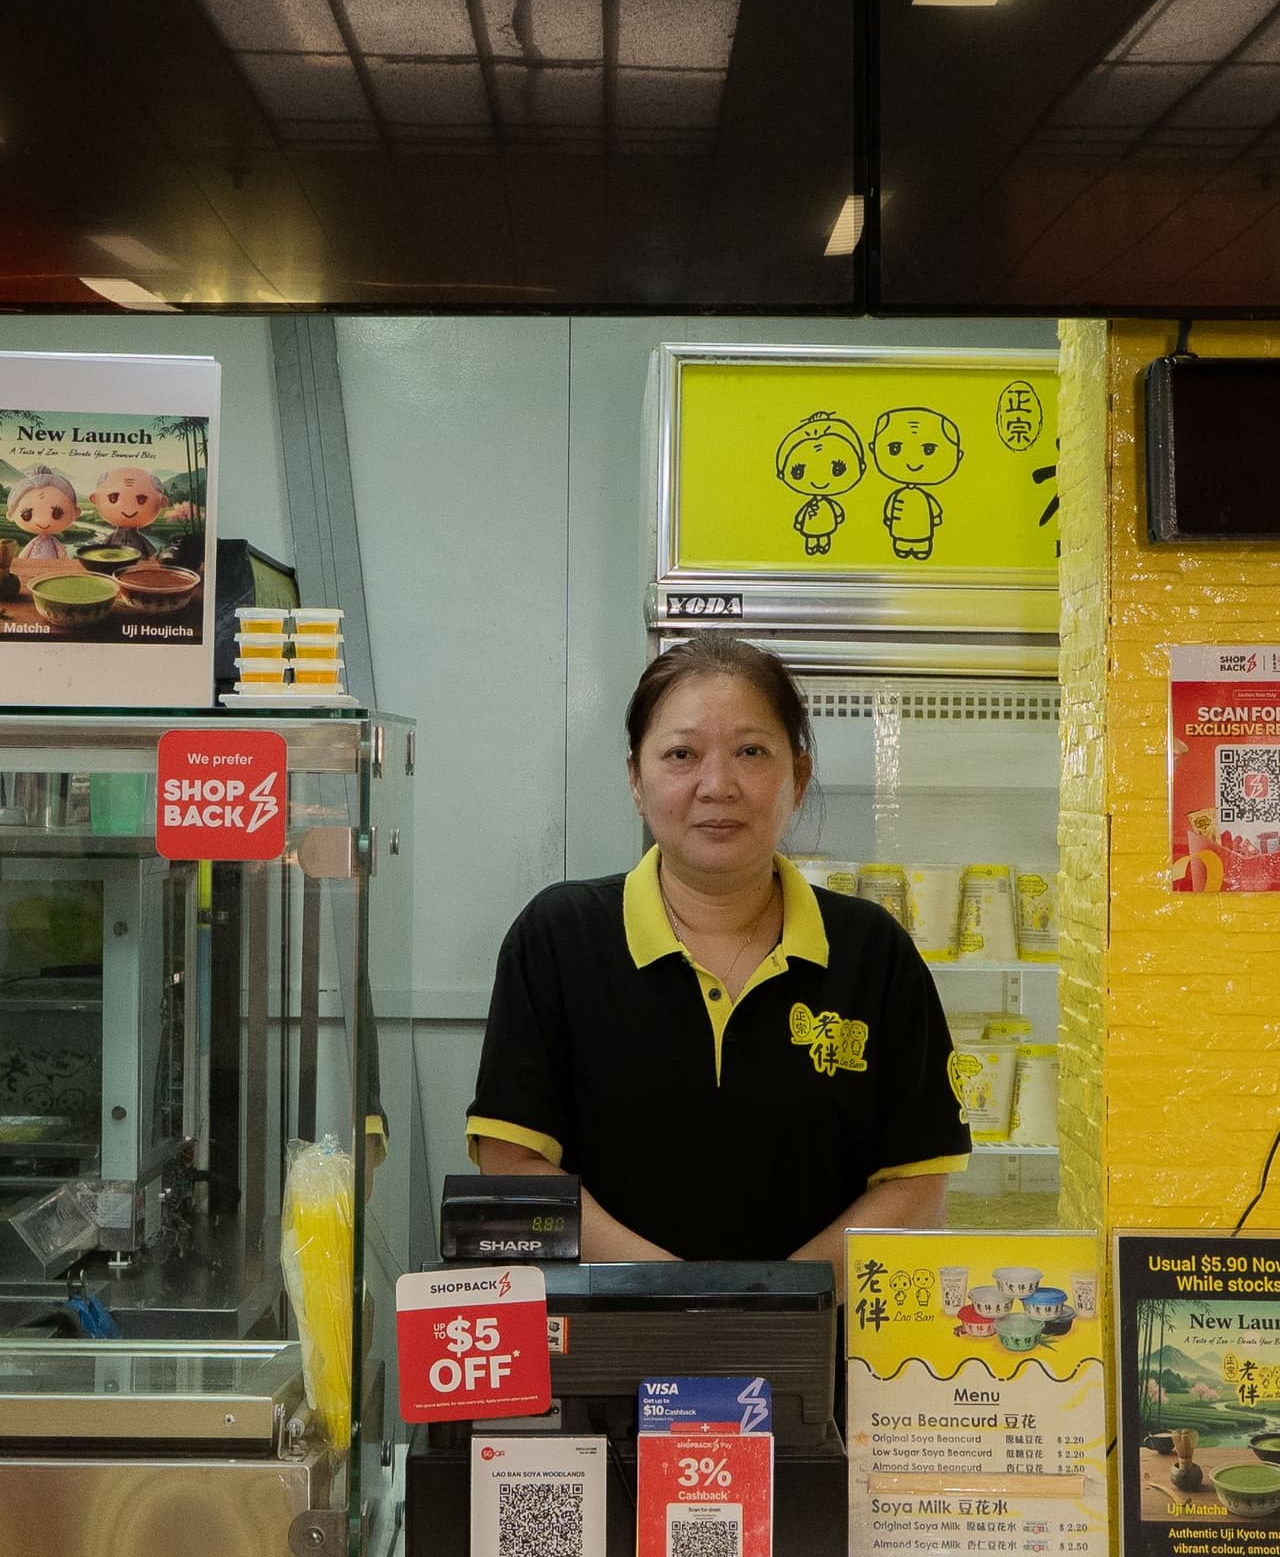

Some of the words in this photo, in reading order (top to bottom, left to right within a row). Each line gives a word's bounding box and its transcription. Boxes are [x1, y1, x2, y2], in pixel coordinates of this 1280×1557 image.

[1007, 389, 1032, 444] 正宗
[17, 425, 65, 442] New
[72, 427, 153, 445] Launch
[4, 621, 50, 635] Matcha
[121, 624, 138, 638] Uji
[141, 625, 194, 639] Houjicha
[1220, 655, 1246, 664] SHOP
[1220, 664, 1246, 672] BACK
[1198, 707, 1248, 721] SCAN
[1185, 724, 1263, 736] EXCLUSIVE
[187, 753, 209, 764] We
[213, 754, 253, 767] prefer
[163, 779, 245, 802] SHOP
[164, 805, 245, 827] BACK
[813, 1015, 840, 1073] 老伴
[479, 1241, 542, 1251] SHARP
[1149, 1256, 1195, 1272] Usual
[1201, 1254, 1247, 1274] $5.90
[430, 1281, 497, 1293] SHOPBACK
[1176, 1275, 1223, 1291] While
[856, 1258, 889, 1332] 老伴
[893, 1311, 912, 1322] Lao
[914, 1311, 935, 1322] Ban
[1189, 1313, 1232, 1329] New
[433, 1323, 446, 1332] UP
[446, 1315, 500, 1358] $5
[643, 1383, 678, 1395] VISA
[1239, 1360, 1259, 1404] 老伴
[954, 1388, 1000, 1402] Menu
[643, 1405, 664, 1417] $10
[871, 1412, 912, 1430] Soya
[918, 1413, 997, 1427] Beancurd
[1004, 1413, 1036, 1429] 豆花
[872, 1434, 909, 1443] Original
[911, 1434, 934, 1444] Soya
[873, 1448, 890, 1456] Low
[893, 1448, 920, 1458] Sugar
[922, 1448, 945, 1458] Soya
[948, 1449, 992, 1457] Beancurd
[678, 1458, 732, 1487] 3%
[873, 1462, 908, 1471] Almond
[912, 1463, 934, 1472] Soya
[938, 1463, 981, 1471] Beancurd
[872, 1499, 912, 1516] Soya
[919, 1500, 952, 1514] Milk
[958, 1499, 1008, 1515] 豆花水
[1168, 1503, 1183, 1517] Uji
[1186, 1504, 1227, 1515] Matcha
[873, 1521, 911, 1531] Original
[914, 1522, 938, 1532] Soya
[941, 1522, 960, 1530] Milk
[1168, 1528, 1218, 1539] Authentic
[1220, 1528, 1234, 1541] Uji
[1237, 1530, 1266, 1541] Kyoto
[873, 1540, 911, 1548] Almond
[915, 1541, 938, 1550] Soya
[941, 1540, 960, 1549] Milk
[1173, 1543, 1209, 1554] vibrant
[1211, 1544, 1246, 1555] colour,
